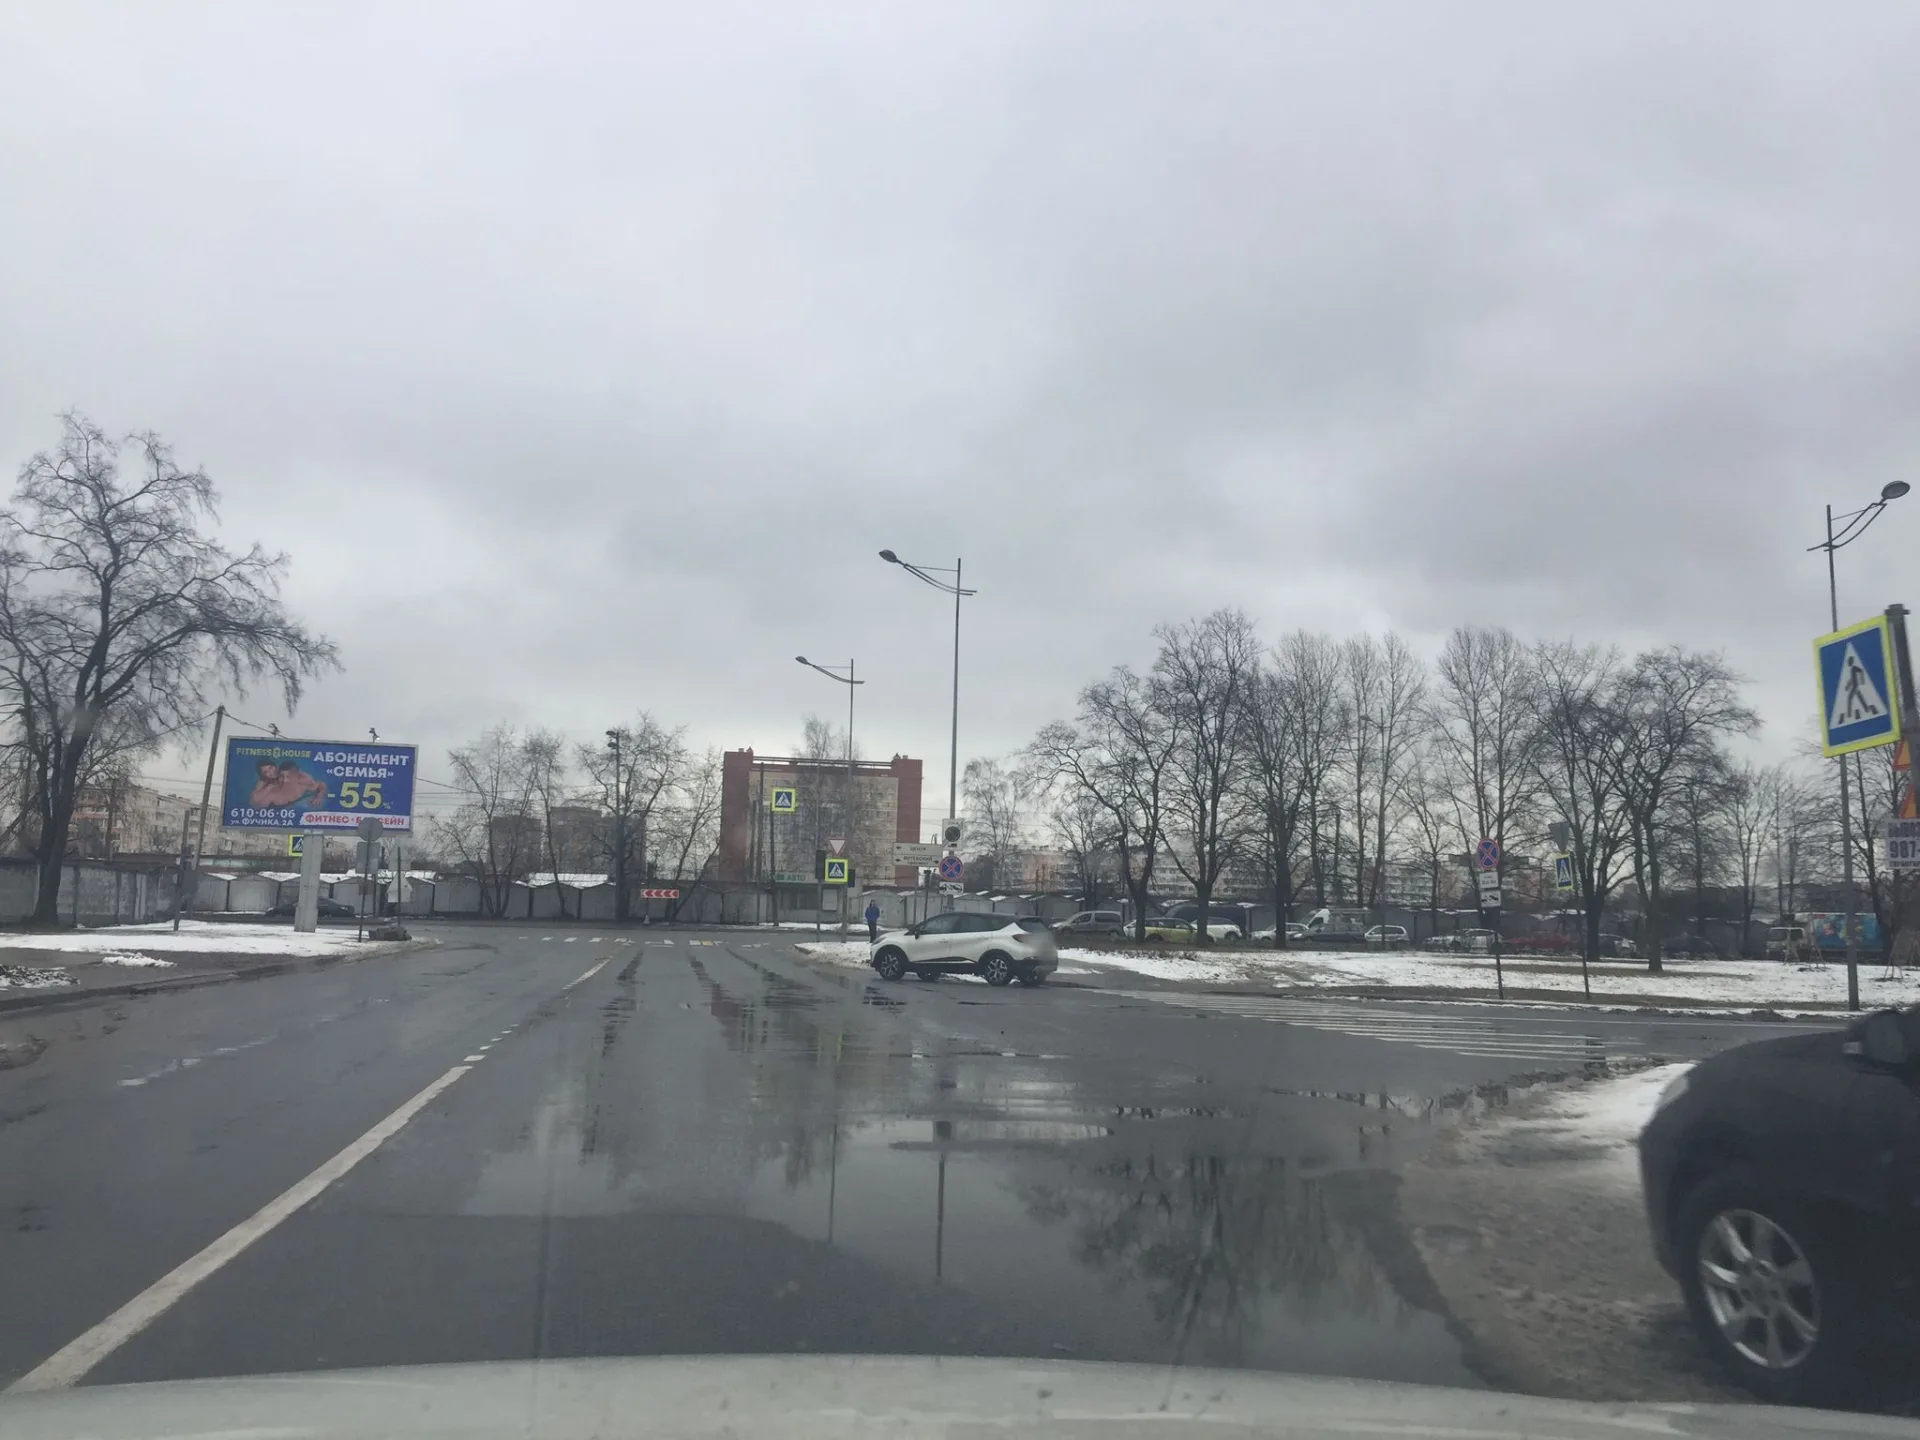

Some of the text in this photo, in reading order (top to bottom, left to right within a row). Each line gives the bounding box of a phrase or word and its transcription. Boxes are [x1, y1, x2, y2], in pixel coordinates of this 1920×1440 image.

[236, 748, 312, 758] FITNESS HOUSE
[314, 752, 409, 766] АБОНЕМЕНТ
[326, 766, 394, 779] «СЕМЬЯ»
[305, 814, 404, 826] ФИТНЕС БСЕЙН
